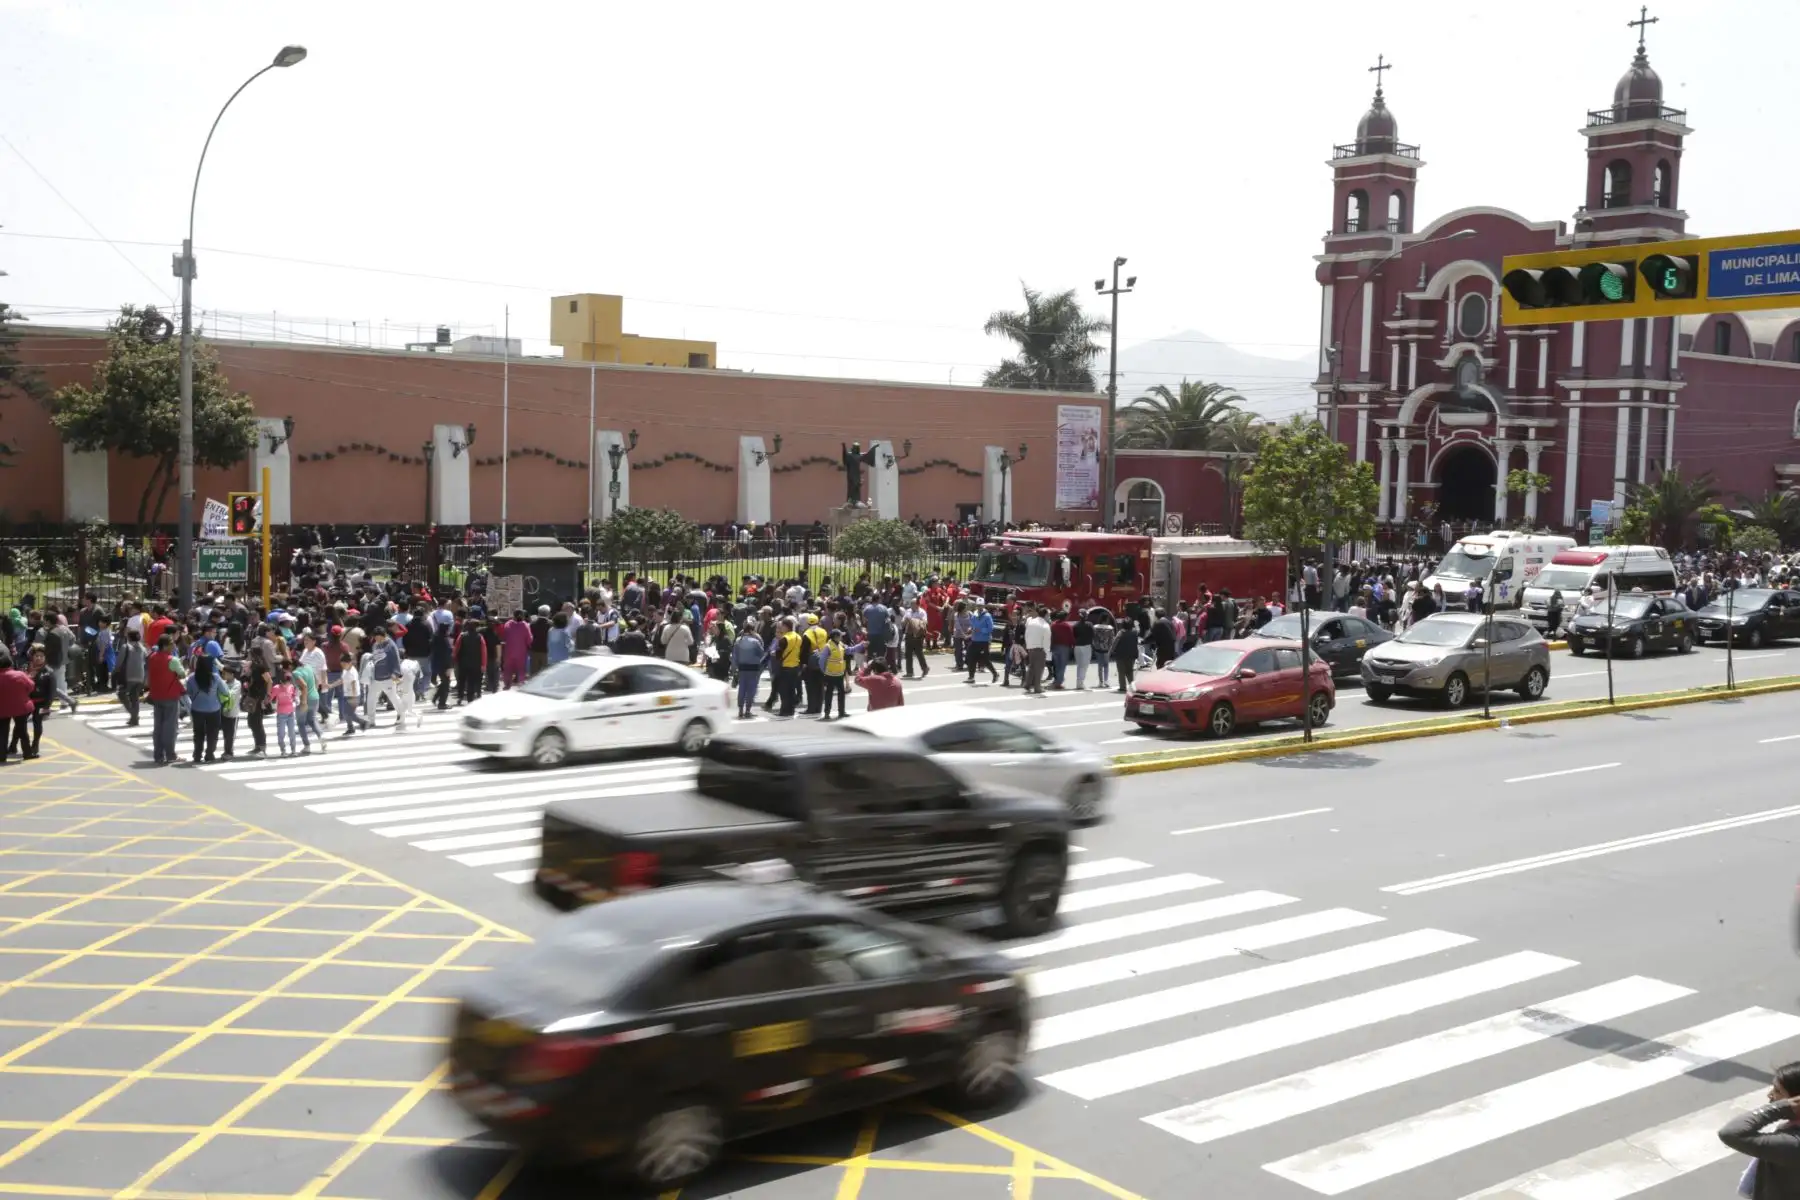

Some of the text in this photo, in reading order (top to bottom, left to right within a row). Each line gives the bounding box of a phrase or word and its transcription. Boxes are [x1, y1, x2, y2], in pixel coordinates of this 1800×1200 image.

[1664, 267, 1676, 289] 6
[1744, 270, 1800, 286] DE LIMA
[202, 548, 242, 556] ENTRADA
[211, 562, 234, 570] POZO
